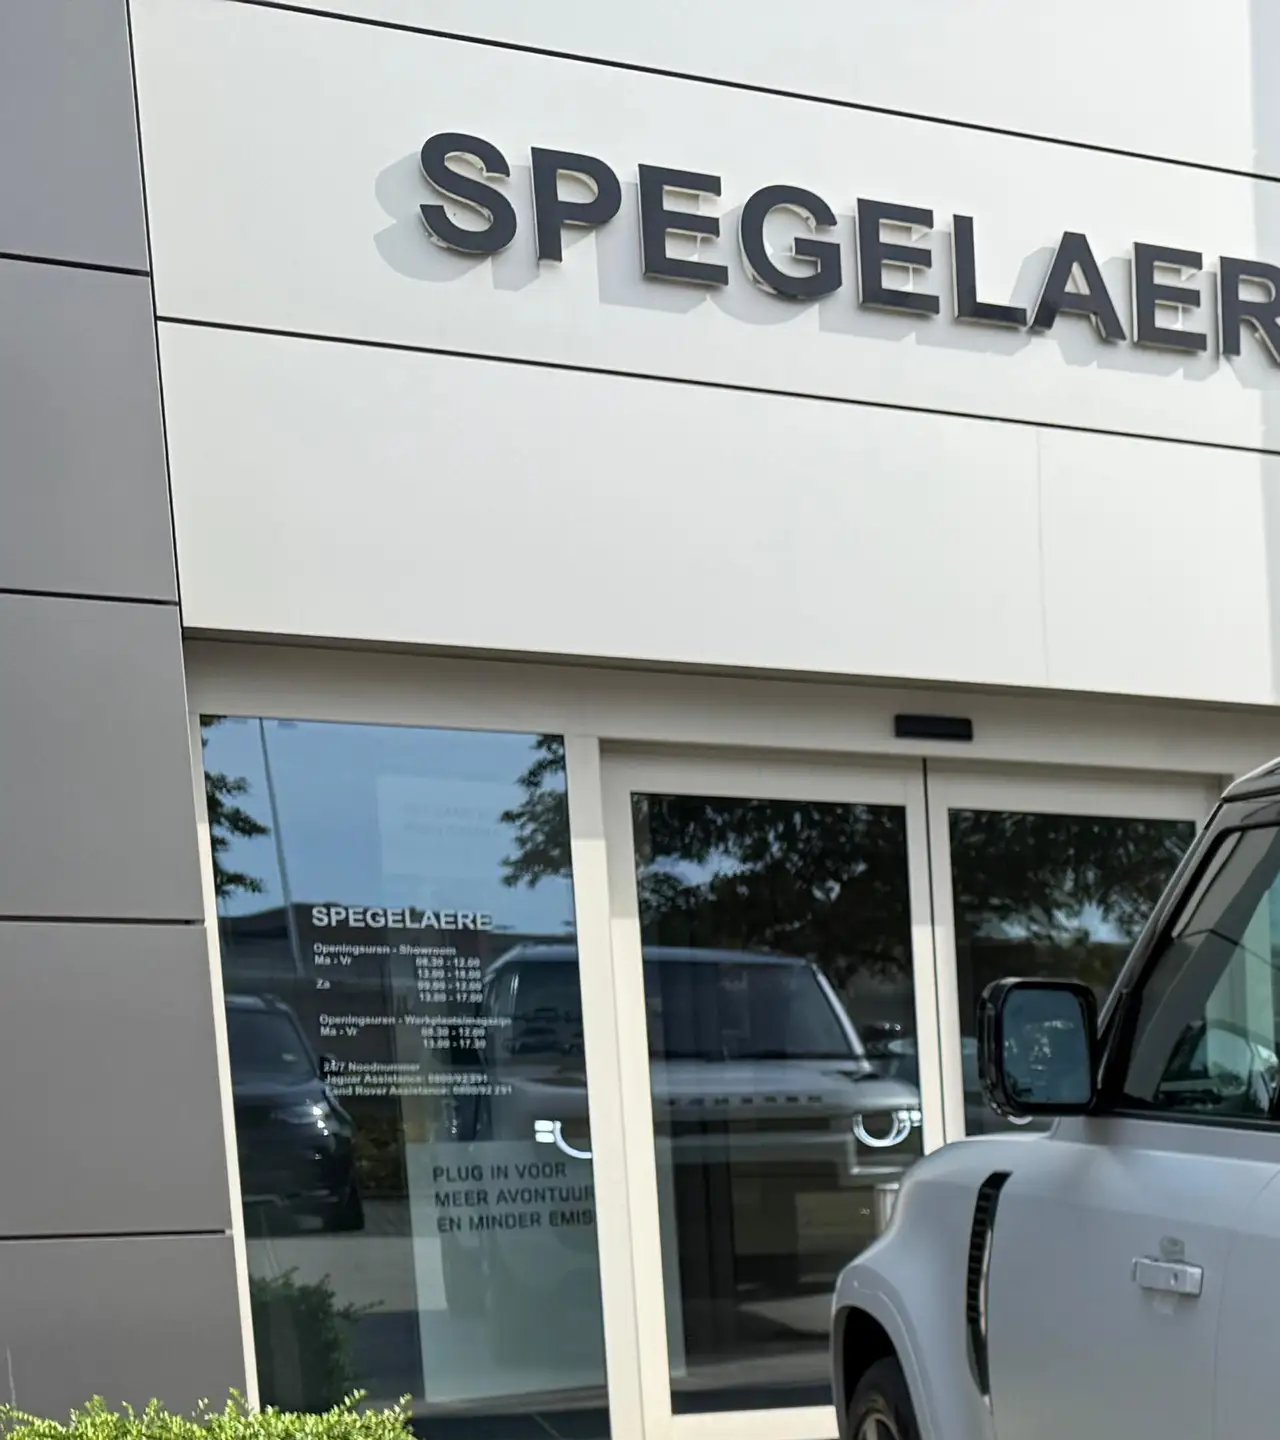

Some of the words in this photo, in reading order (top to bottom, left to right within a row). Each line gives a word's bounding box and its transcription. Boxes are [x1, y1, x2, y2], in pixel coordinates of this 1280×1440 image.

[311, 906, 494, 931] SPEGELAERE
[433, 1165, 483, 1182] PLUG
[491, 1164, 508, 1180] IN
[515, 1162, 567, 1179] VOOR
[435, 1190, 489, 1207] MEER
[437, 1215, 461, 1233] EN
[469, 1211, 542, 1231] MINDER
